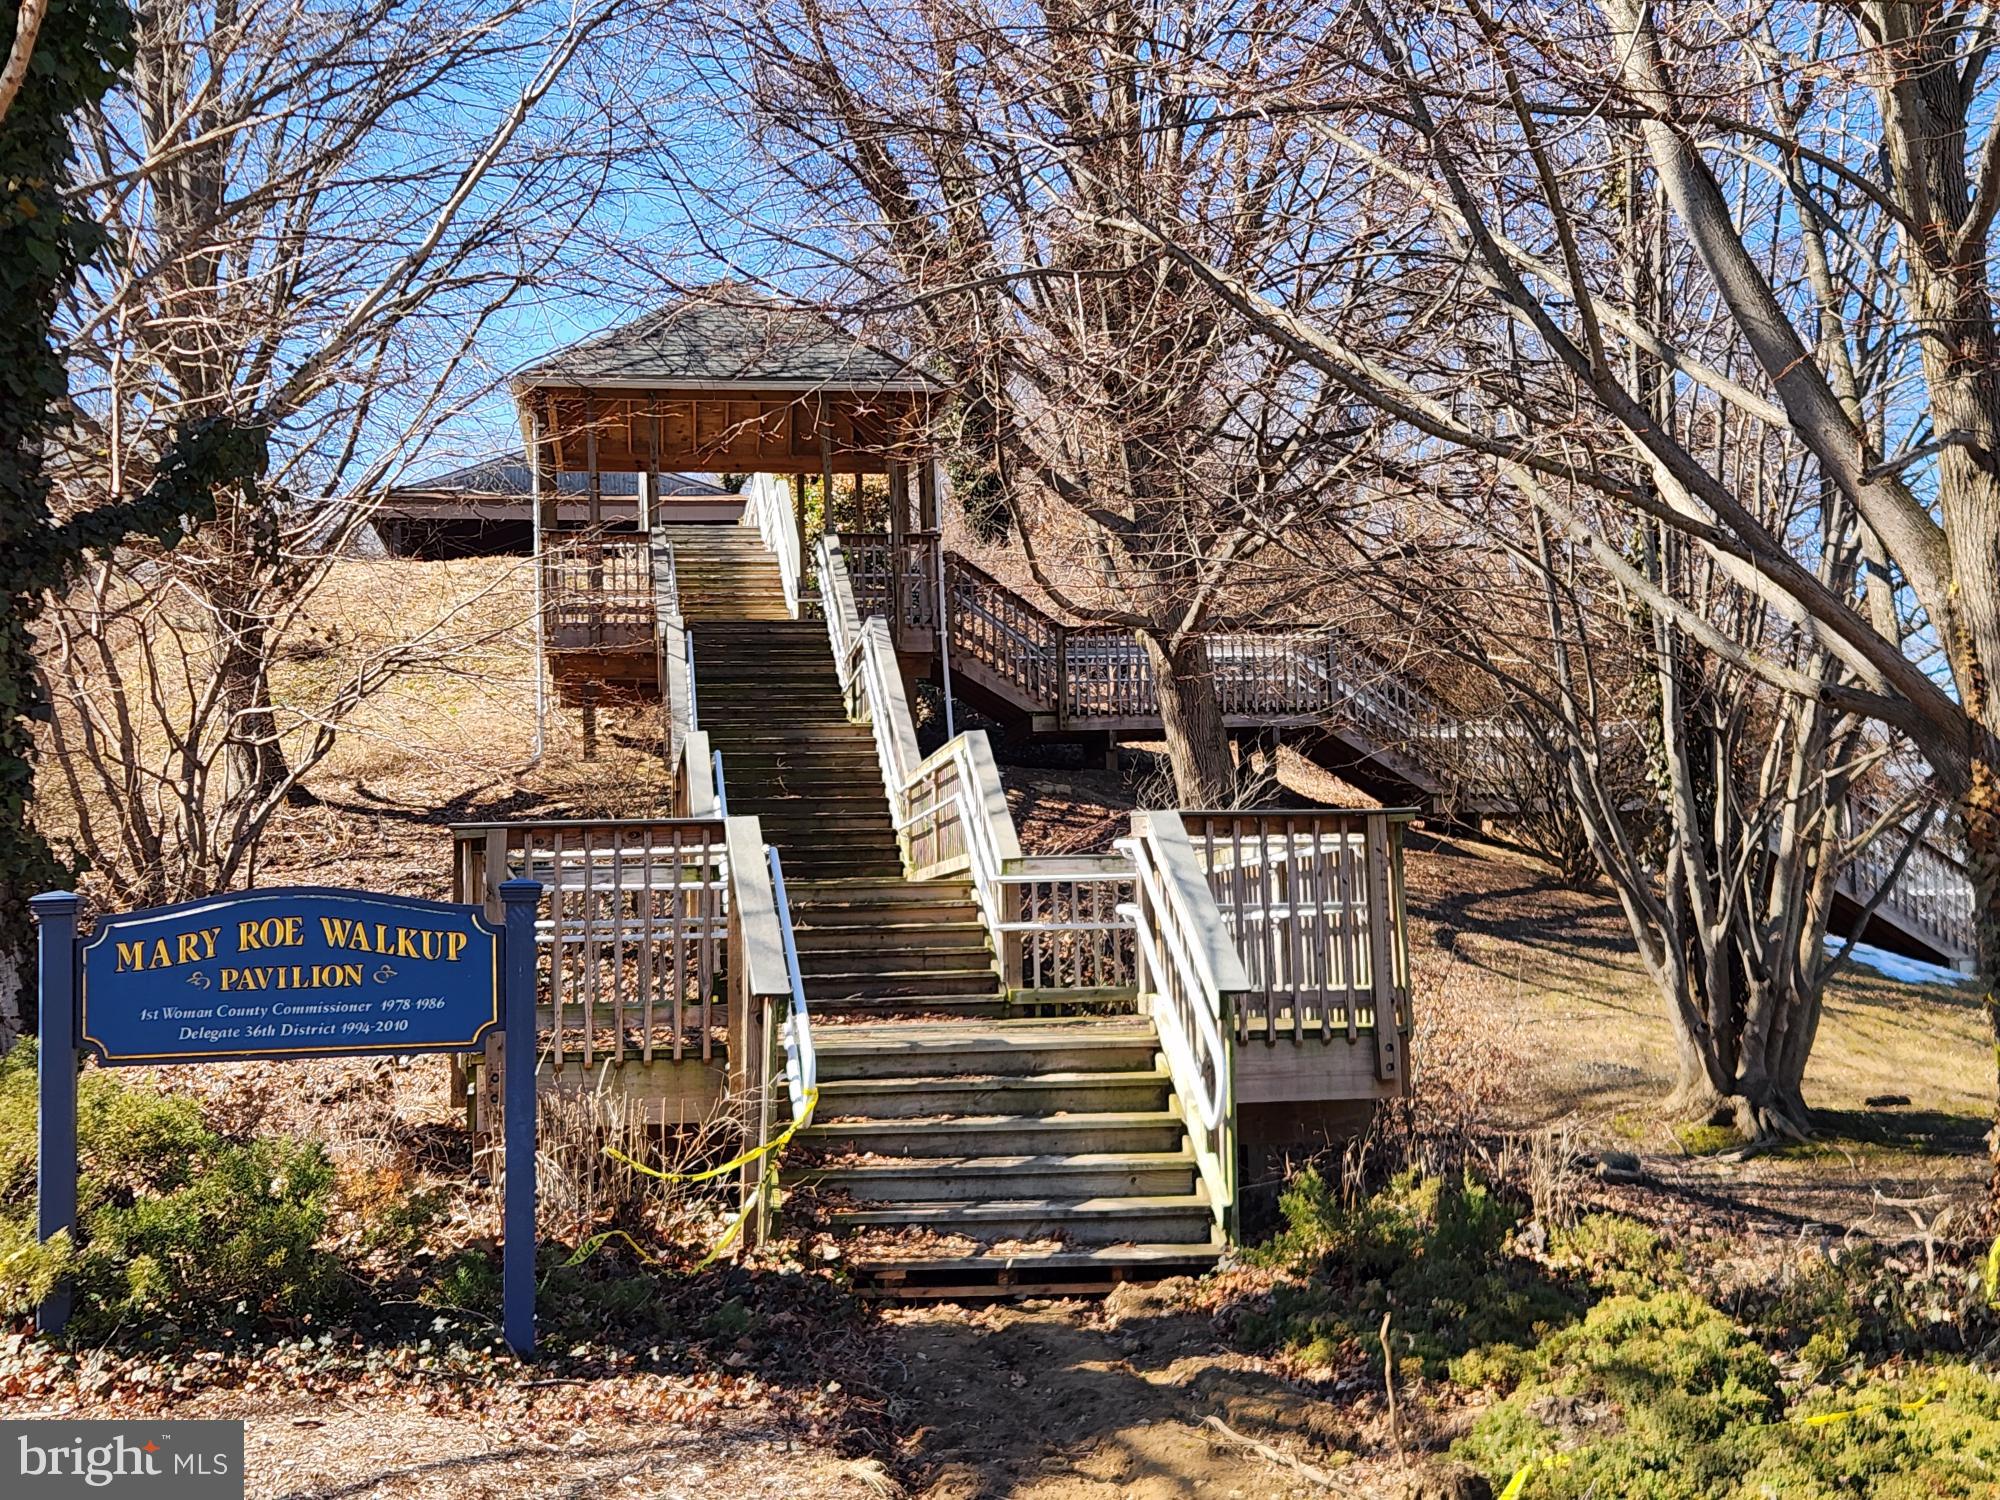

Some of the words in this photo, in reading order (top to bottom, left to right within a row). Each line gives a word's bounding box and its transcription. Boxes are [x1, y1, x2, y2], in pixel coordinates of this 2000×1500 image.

[116, 927, 222, 973] MARY
[237, 916, 304, 951] ROE
[319, 917, 467, 961] WALKUP
[219, 963, 364, 991] PAVILION
[140, 1008, 160, 1021] 1st
[162, 1005, 213, 1020] Woman
[216, 1003, 268, 1021] County
[271, 1000, 372, 1016] Commissioner
[178, 1025, 240, 1042] Delegate
[244, 1025, 276, 1038] 36th
[280, 1022, 336, 1037] District
[341, 1019, 409, 1035] 1994-2010
